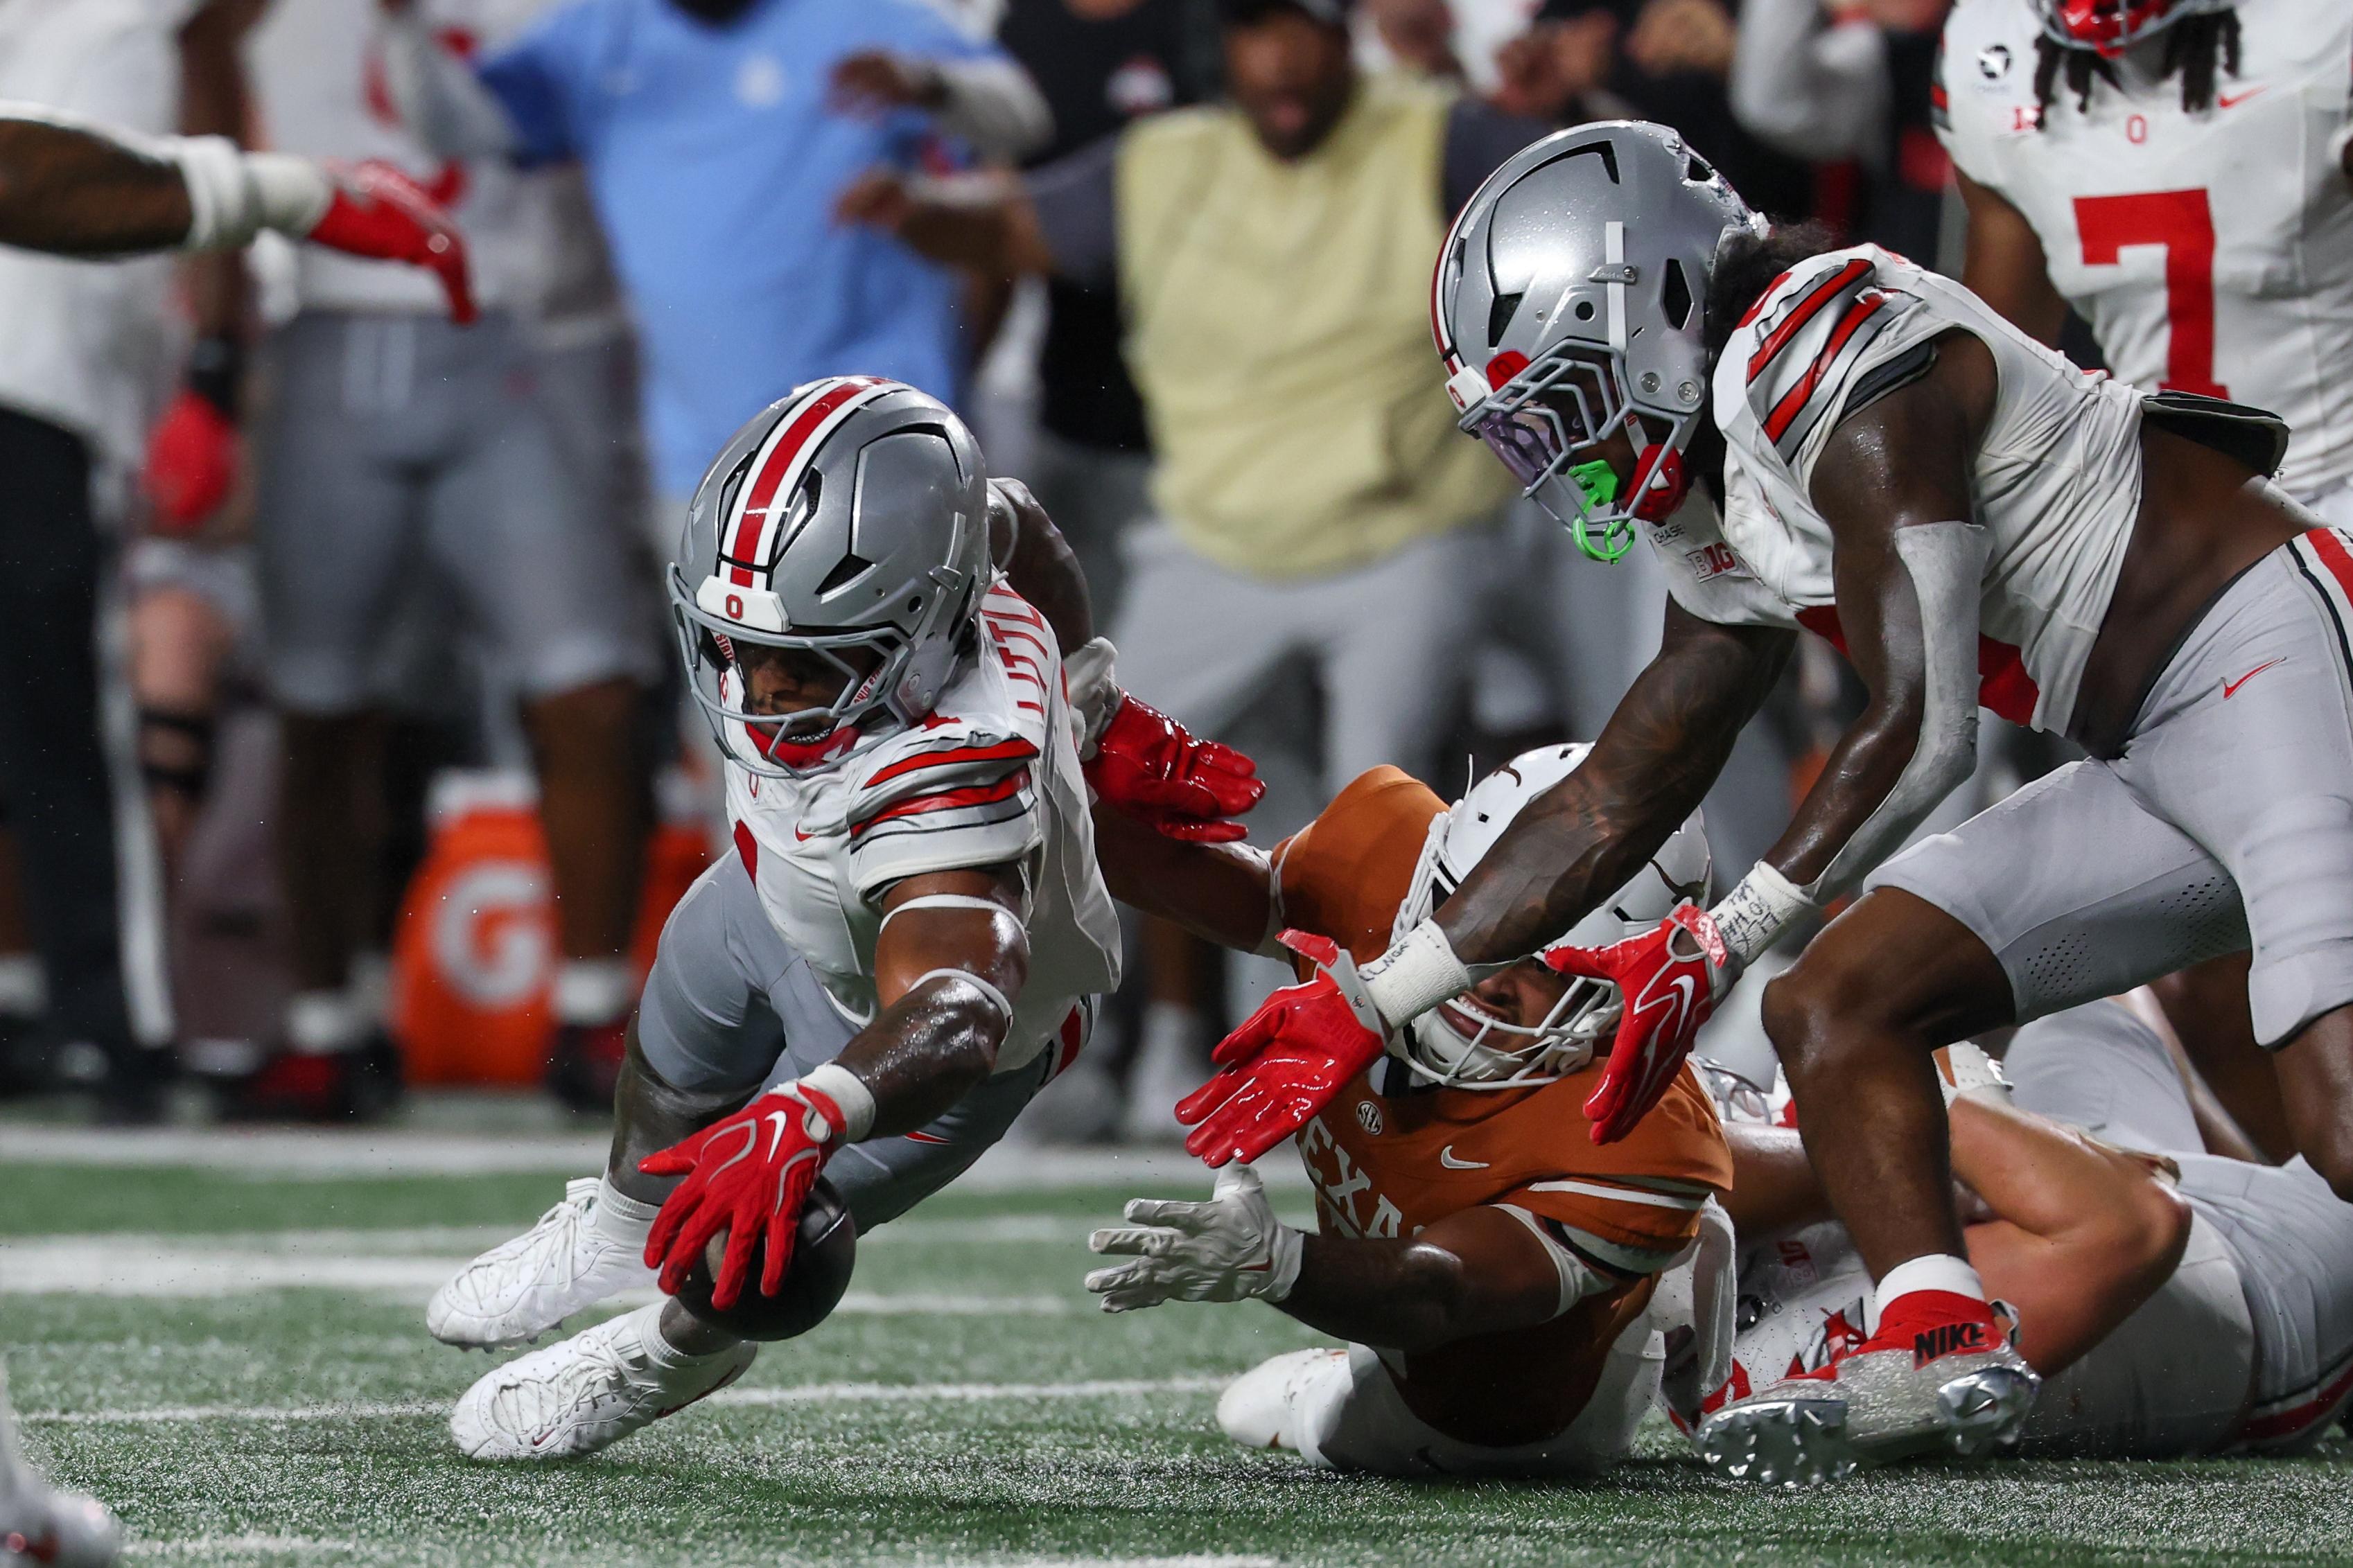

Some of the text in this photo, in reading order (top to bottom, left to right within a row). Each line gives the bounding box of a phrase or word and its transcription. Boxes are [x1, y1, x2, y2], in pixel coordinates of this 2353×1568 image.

[2072, 187, 2232, 401] 7
[726, 594, 744, 620] O
[1300, 1114, 1426, 1239] EXA
[1914, 1322, 1988, 1367] NIKE
